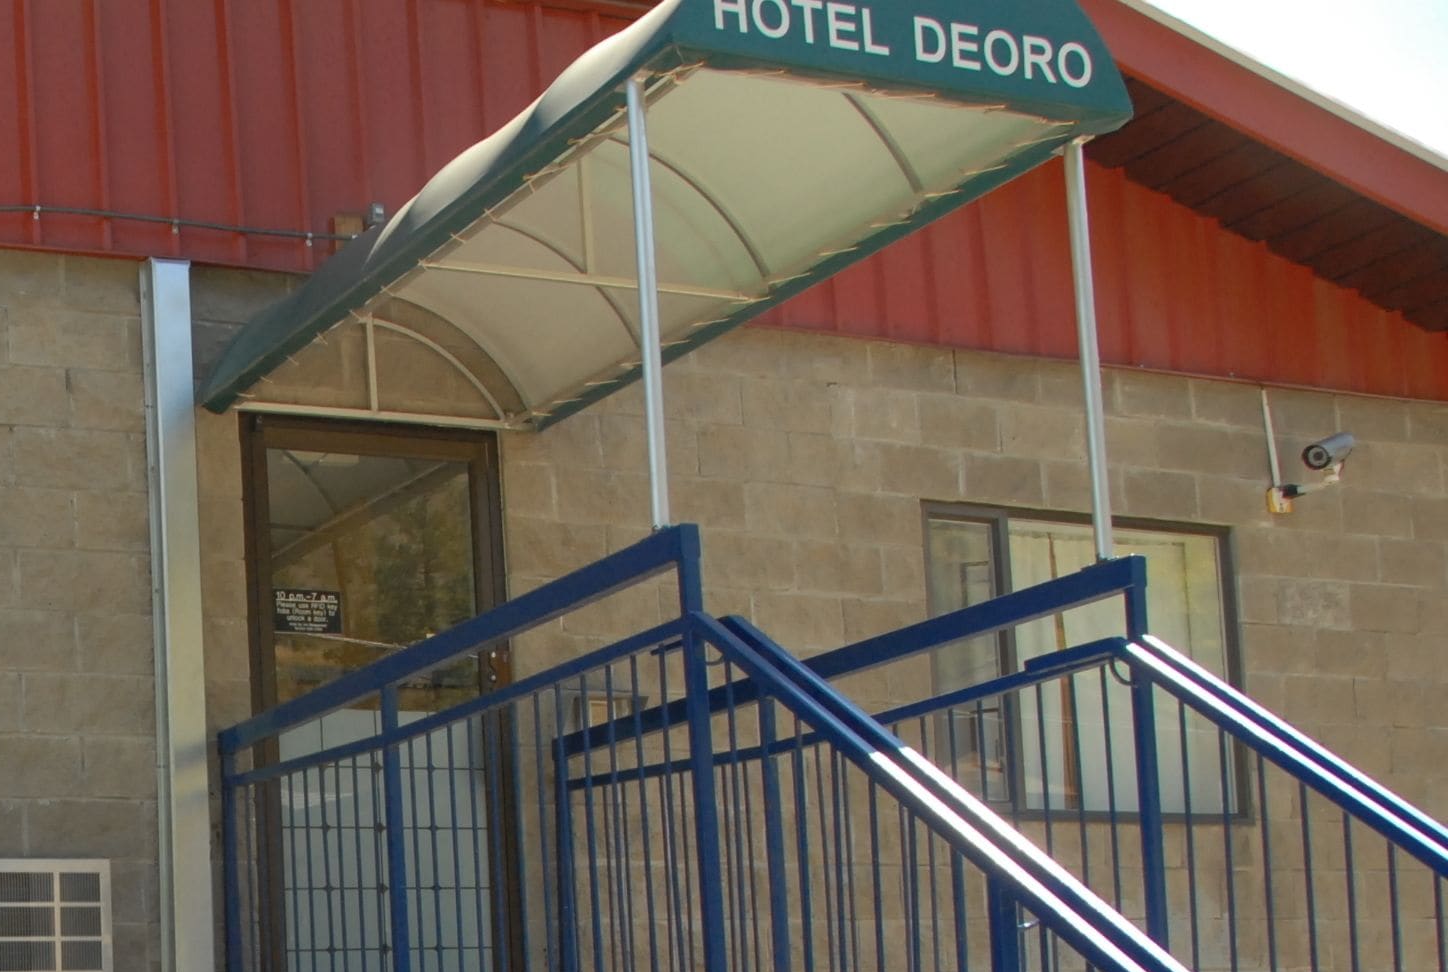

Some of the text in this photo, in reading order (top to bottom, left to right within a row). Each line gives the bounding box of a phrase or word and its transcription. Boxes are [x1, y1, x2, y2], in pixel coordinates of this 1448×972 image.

[713, 0, 1093, 89] HOTEL DEORO
[276, 591, 286, 600] 10
